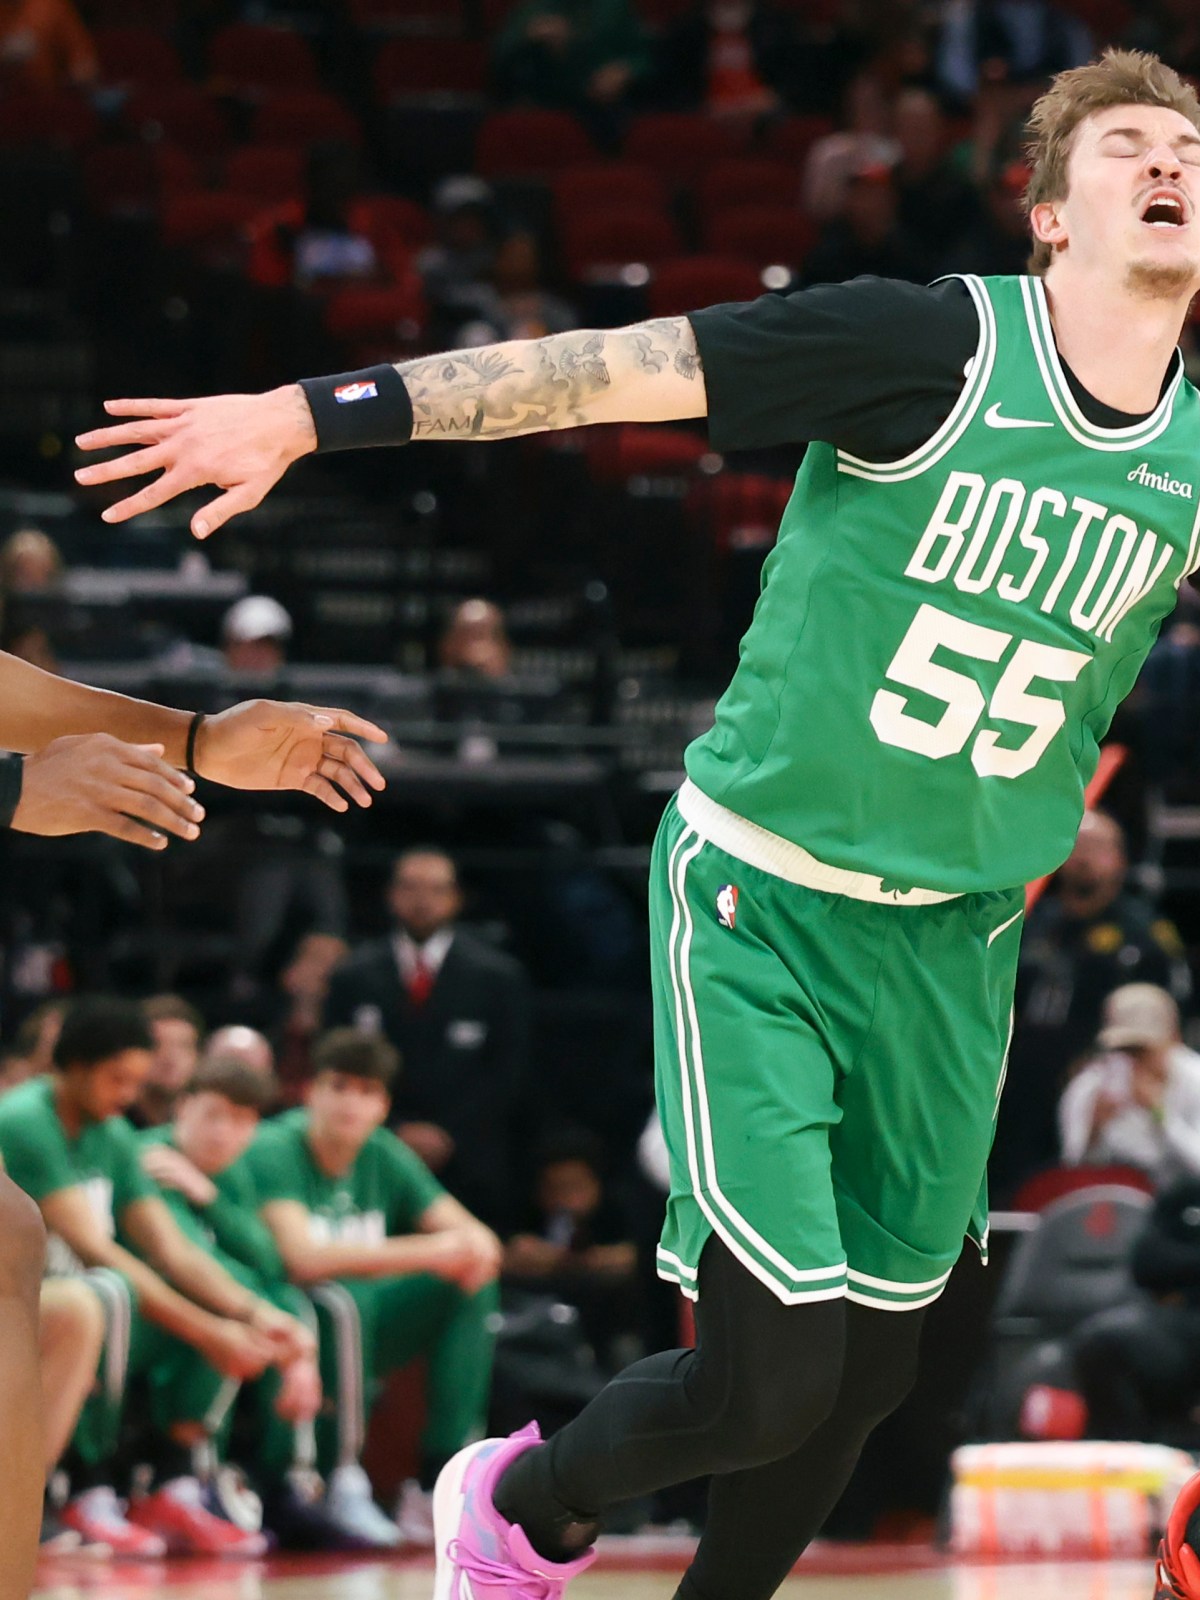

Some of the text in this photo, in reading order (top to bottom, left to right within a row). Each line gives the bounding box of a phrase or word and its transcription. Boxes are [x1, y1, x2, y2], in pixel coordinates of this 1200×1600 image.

[903, 470, 1174, 644] BOSTON
[1126, 462, 1193, 499] Amica
[868, 602, 1094, 779] 55
